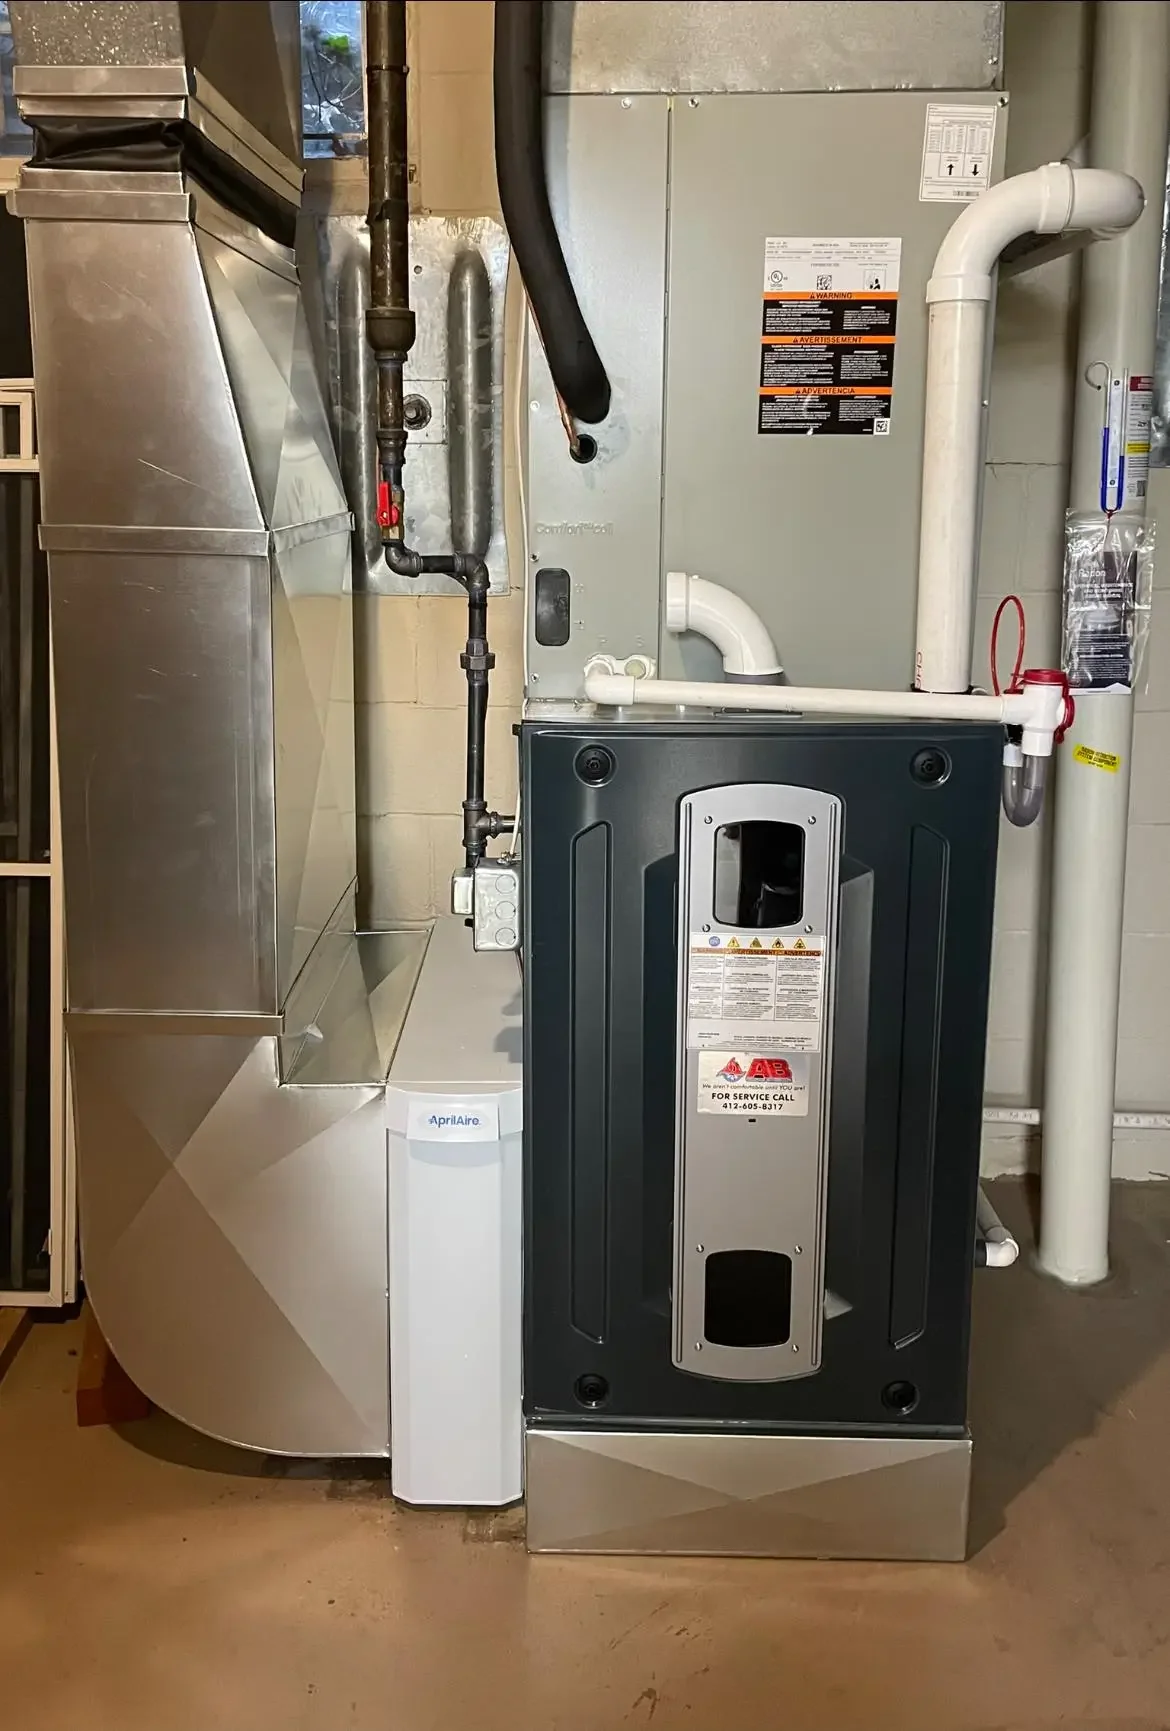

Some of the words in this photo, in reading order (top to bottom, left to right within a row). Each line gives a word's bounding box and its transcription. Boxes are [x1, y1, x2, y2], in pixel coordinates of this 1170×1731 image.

[800, 336, 863, 344] AVERTISSEMENT
[745, 1058, 793, 1083] AB
[711, 1092, 730, 1100] FOR
[733, 1093, 769, 1101] SERVICE
[772, 1094, 795, 1102] CALL
[722, 1102, 783, 1111] 412-605-8317
[427, 1114, 480, 1128] AprilAire
